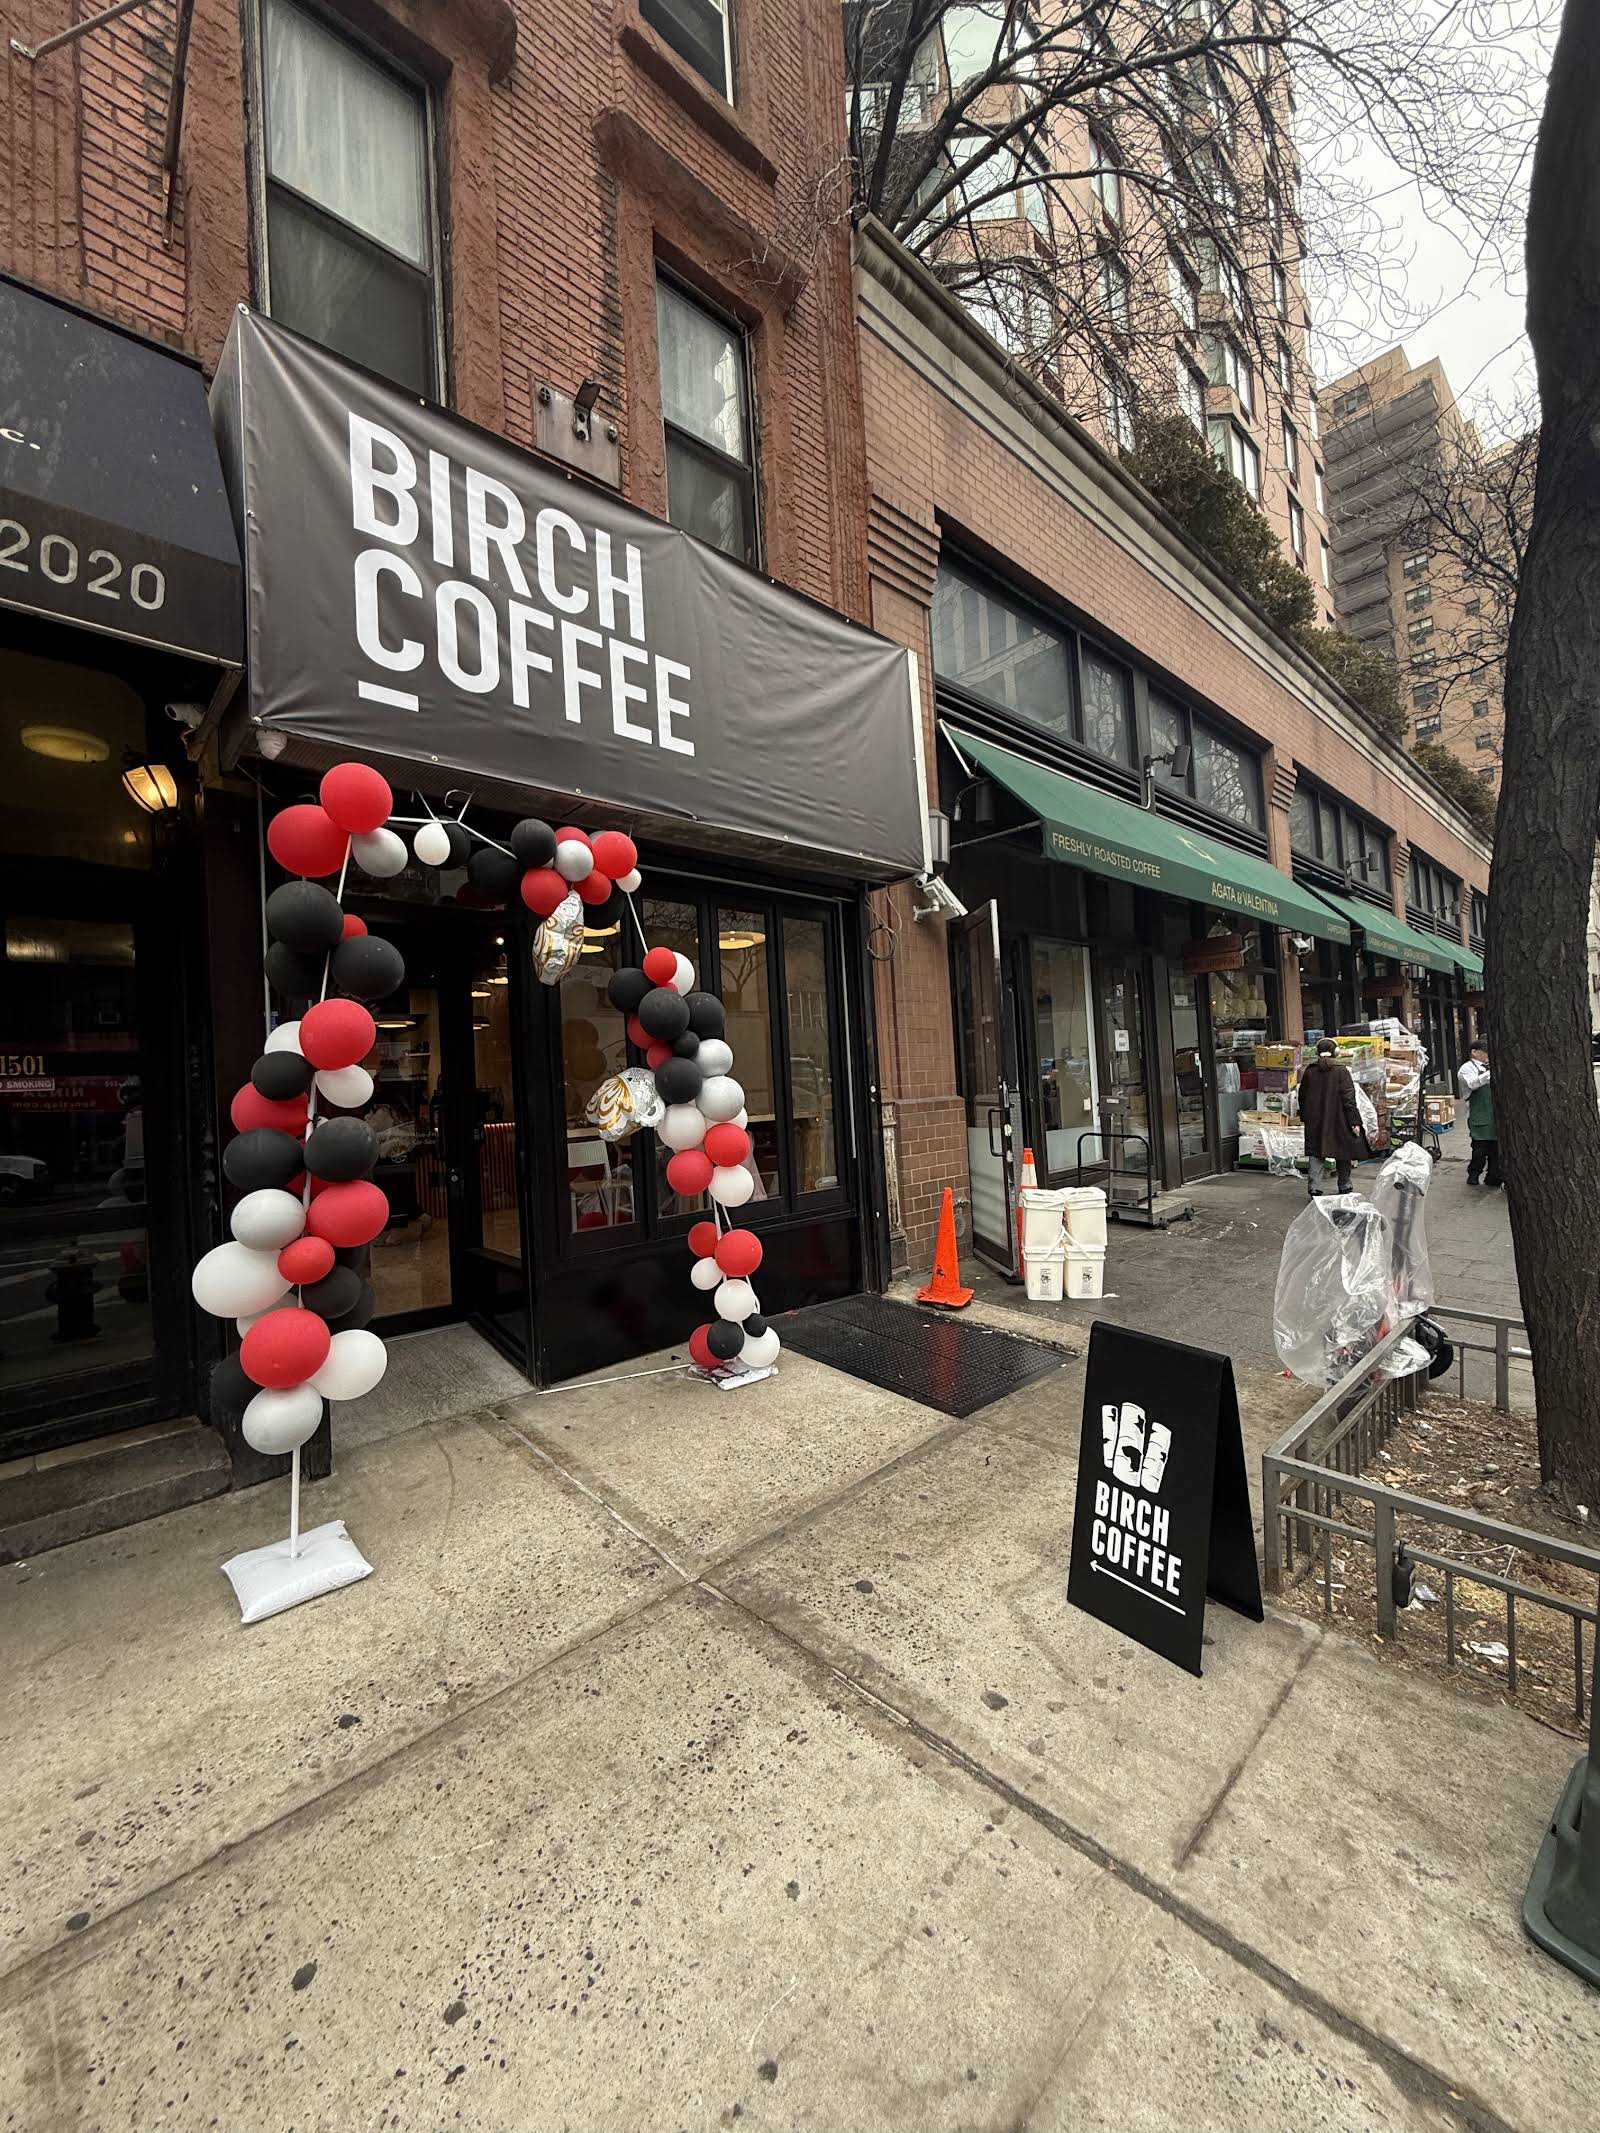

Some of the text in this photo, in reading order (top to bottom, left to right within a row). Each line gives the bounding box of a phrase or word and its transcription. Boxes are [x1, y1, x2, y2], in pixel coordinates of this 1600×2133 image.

[349, 410, 646, 642] BIRCH
[353, 548, 696, 758] COFFEE
[1052, 832, 1161, 879] FRESHLY ROASTED COFFEE
[1211, 881, 1236, 902] AGATA
[1242, 893, 1279, 917] VALENTINA
[6, 1079, 52, 1089] SMOKING
[1094, 1479, 1170, 1547] BIRCH
[1091, 1518, 1182, 1596] COFFEE
